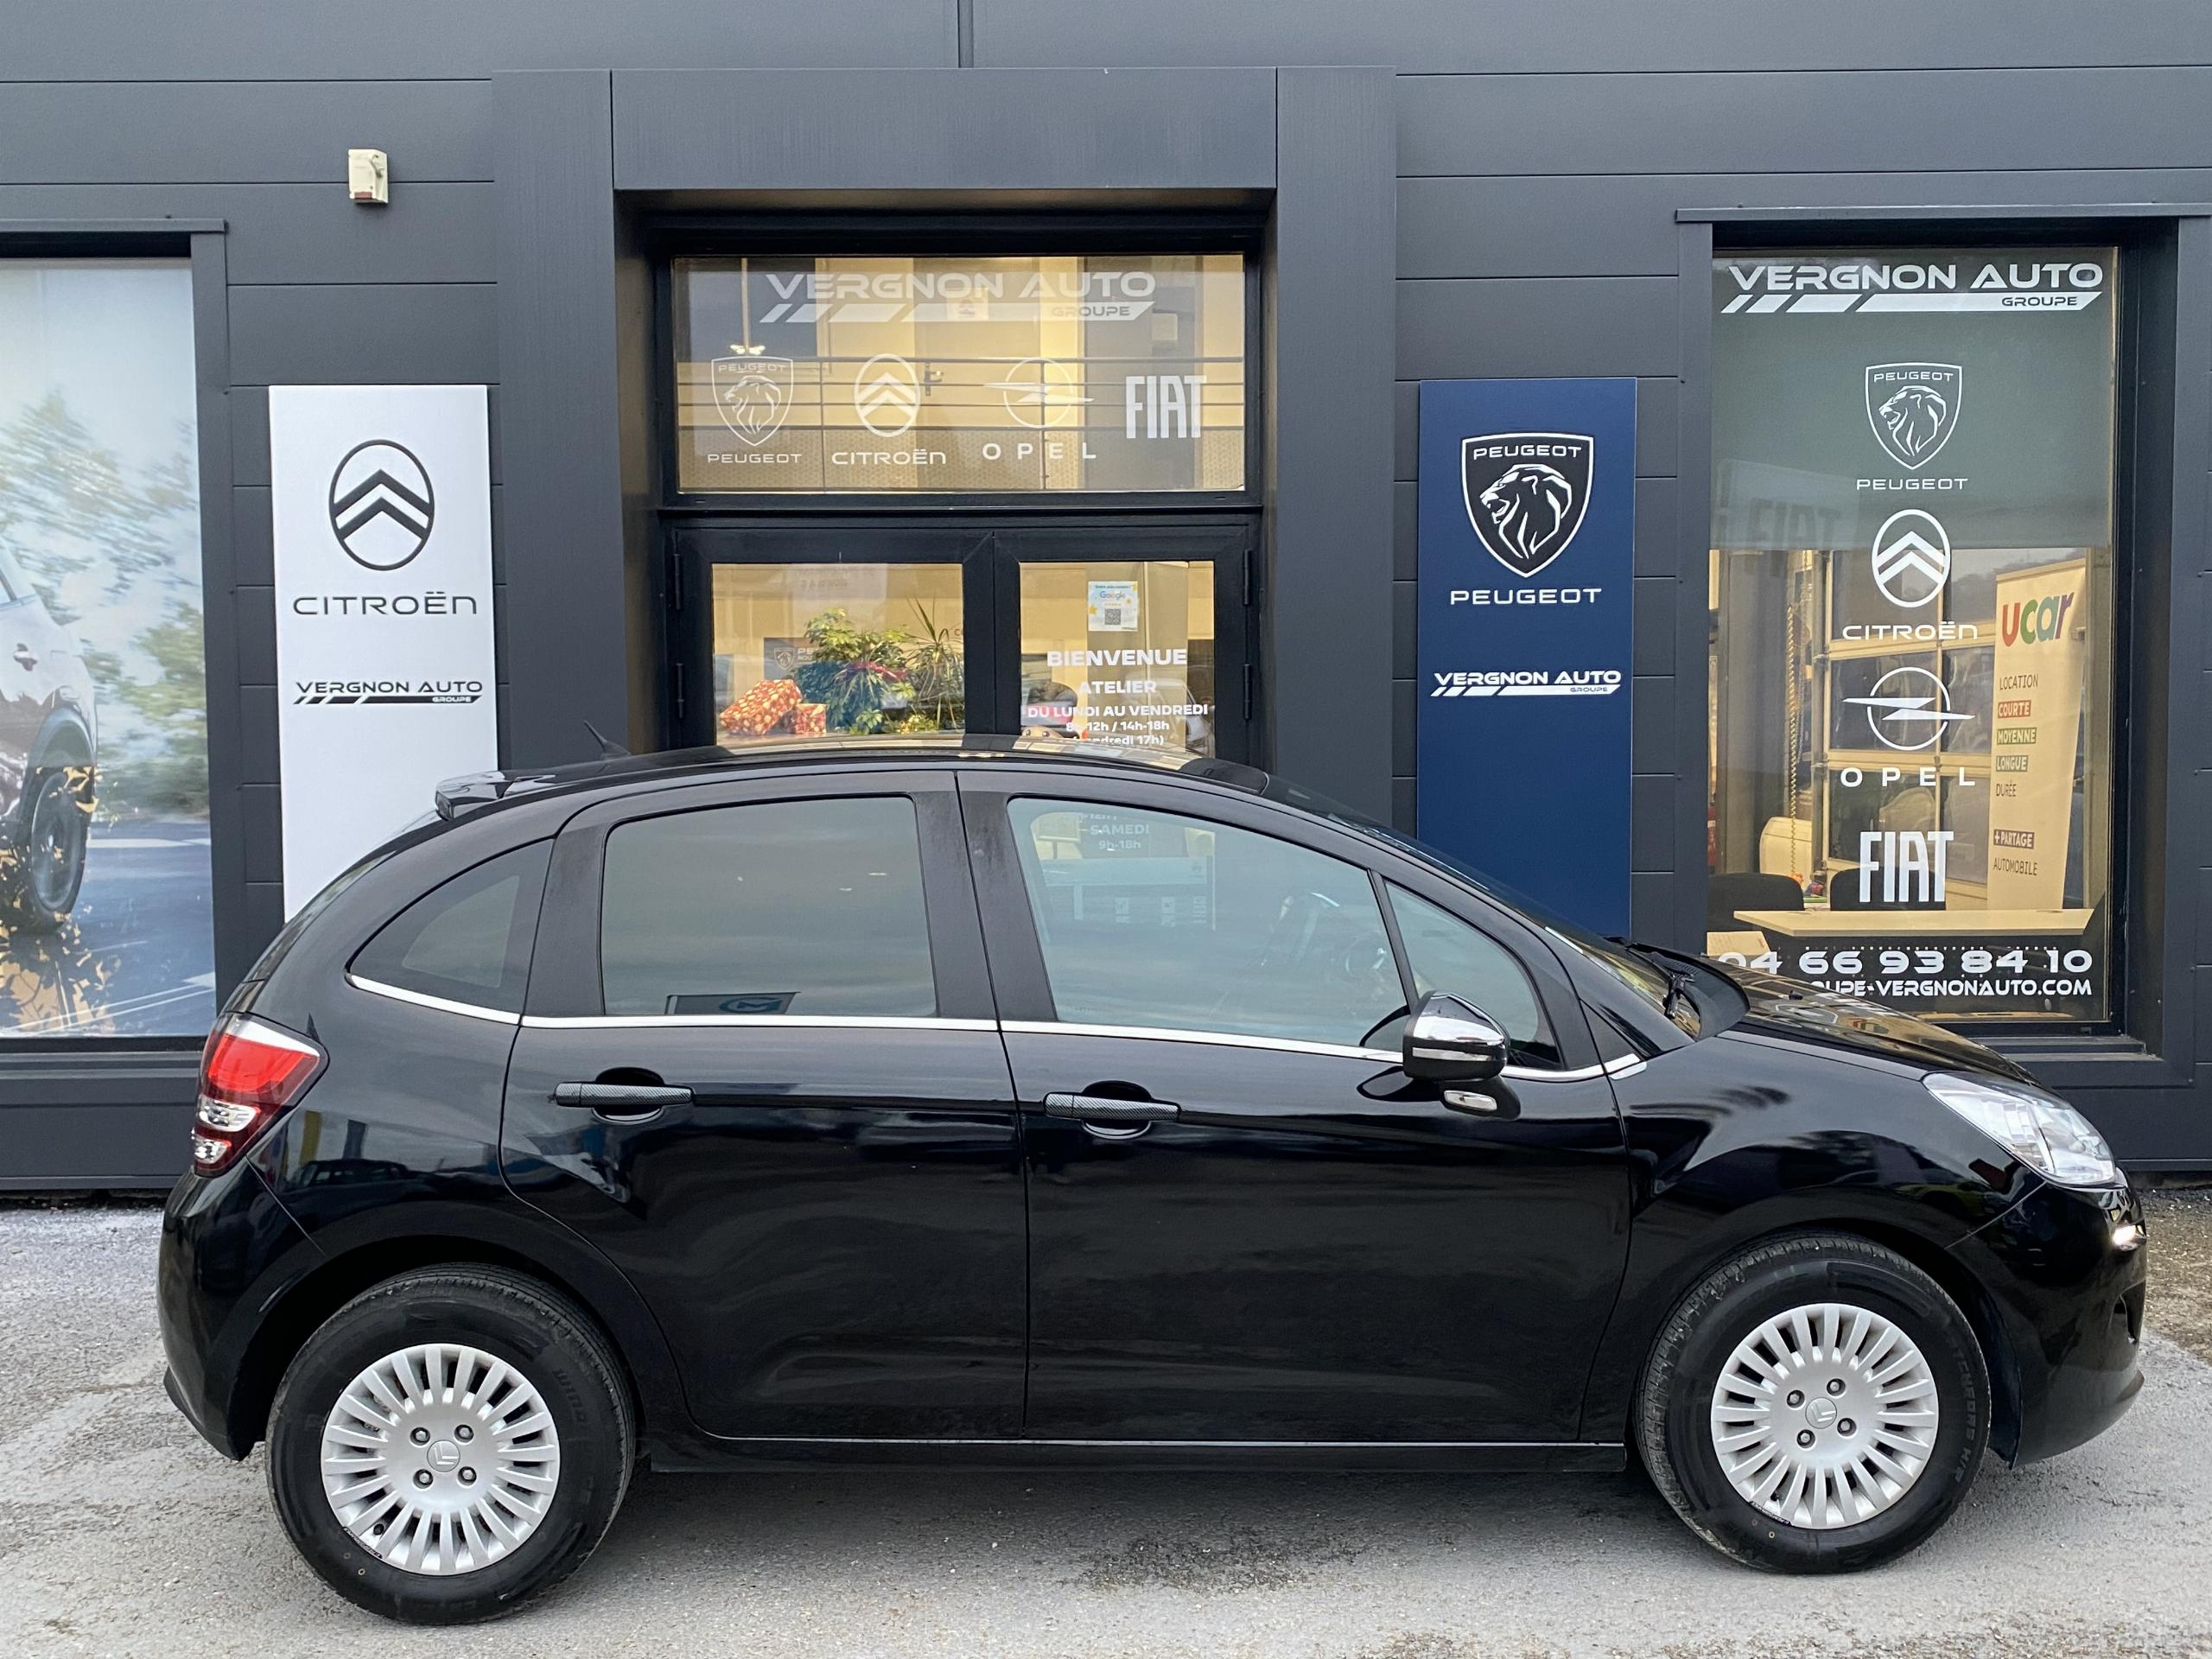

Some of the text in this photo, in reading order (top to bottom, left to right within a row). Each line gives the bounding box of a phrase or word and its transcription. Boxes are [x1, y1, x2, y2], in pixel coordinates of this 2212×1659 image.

[766, 271, 1156, 299] VERGNON AUTO
[1728, 263, 2103, 291] VERGNON AUTO
[2001, 296, 2077, 307] GROUPE
[1052, 306, 1131, 317] GROUPE
[718, 364, 787, 373] PEUGEOT
[1873, 371, 1954, 383] PEUGEOT
[1126, 375, 1207, 439] FIAT
[707, 454, 802, 463] PEUGEOT
[982, 442, 1096, 460] OPEL
[1473, 444, 1582, 461] PEUGEOT
[1857, 478, 1968, 491] PEUGEOT
[1099, 590, 1127, 601] Google
[1450, 588, 1602, 606] PEUGEOT
[2002, 592, 2075, 647] ucar
[1047, 649, 1187, 666] BIENVENUE
[1434, 671, 1621, 685] VERGNON AUTO
[1999, 673, 2039, 690] LOCATION
[296, 681, 483, 693] VERGNON AUTO
[1079, 680, 1157, 695] ATELIER
[1027, 706, 1050, 718] DU
[1103, 705, 1126, 717] AU
[1128, 704, 1208, 716] VENDREDI
[1998, 702, 2031, 717] COURTE
[1066, 721, 1109, 732] 812h
[1121, 721, 1170, 731] 14h-18h
[1998, 728, 2036, 744] MOYENNE
[1997, 756, 2027, 772] LONGUE
[1840, 767, 1975, 787] OPEL
[1995, 779, 2017, 797] DURÉE
[1090, 824, 1149, 836] SAMEDI
[1859, 830, 1955, 903] FIAT
[1993, 857, 2037, 876] AUTOMOBILE
[1799, 951, 1863, 975] 66
[1879, 950, 1944, 975] 93
[1961, 950, 2028, 974] 84
[2046, 950, 2093, 973] 10
